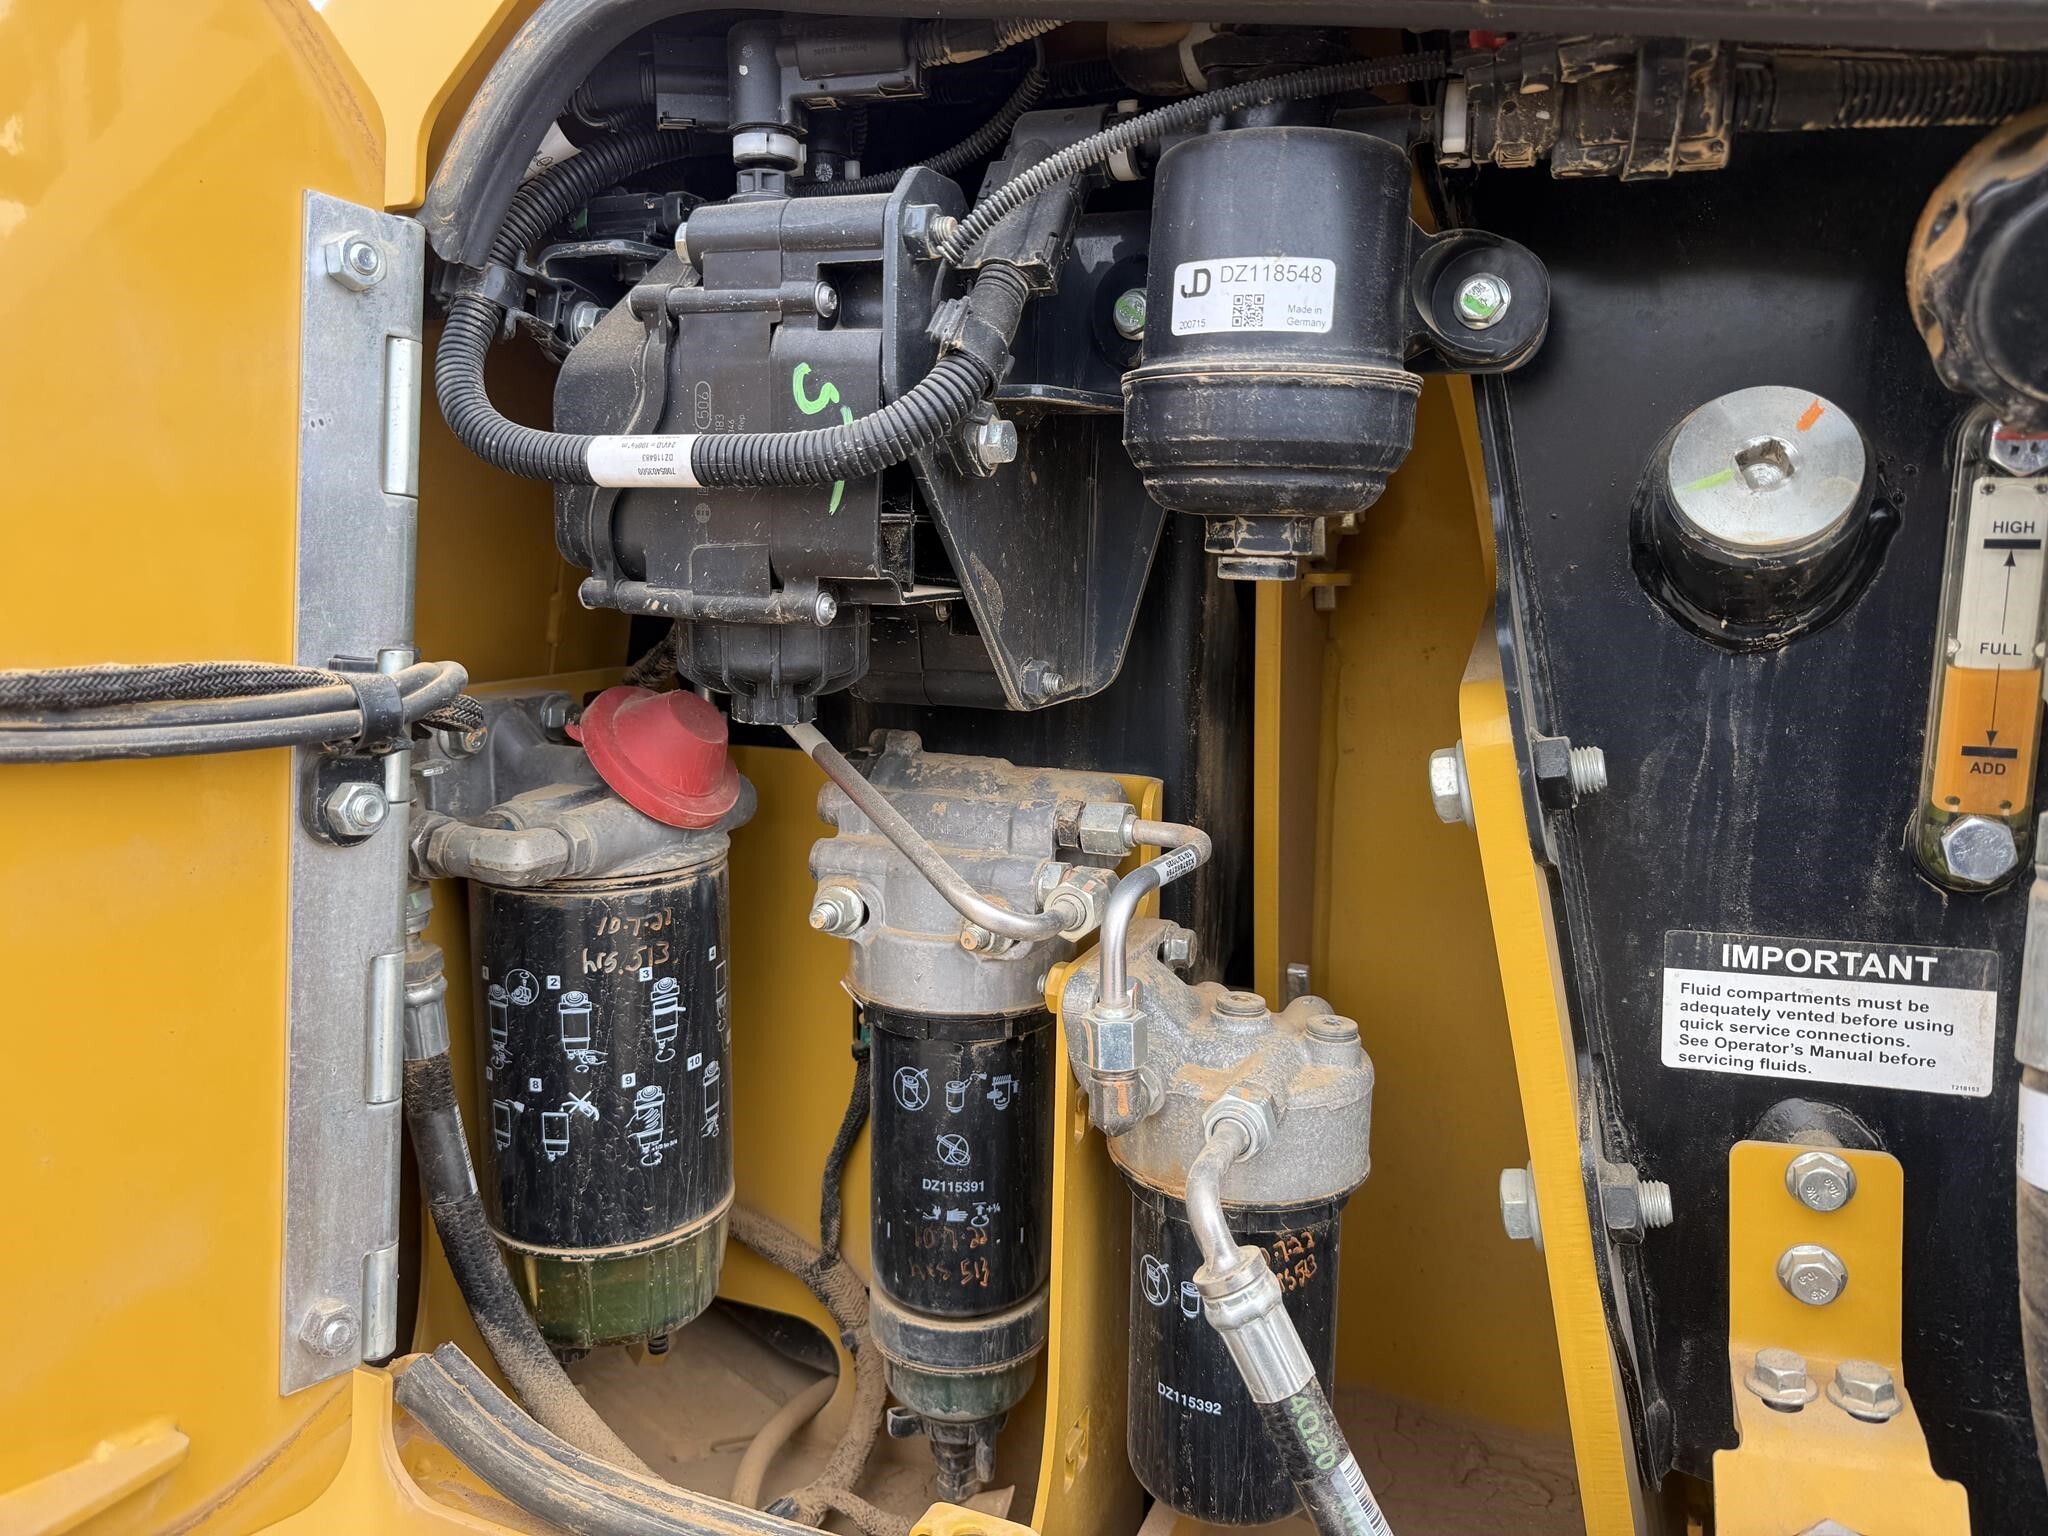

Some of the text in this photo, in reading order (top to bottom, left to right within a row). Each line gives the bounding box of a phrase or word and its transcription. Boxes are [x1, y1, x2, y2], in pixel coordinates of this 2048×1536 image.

[1220, 264, 1323, 283] DZ118548
[1287, 304, 1322, 314] Made in
[1179, 318, 1206, 330] 200715
[1286, 316, 1326, 329] Germany
[698, 391, 710, 419] 506
[1992, 519, 2035, 534] HIGH
[1979, 642, 2022, 657] FULL
[1970, 761, 2006, 776] ADD
[1722, 943, 1938, 982] IMPORTANT
[1680, 982, 1930, 1013] Fluid compartments must be
[1680, 1000, 1954, 1037] adequately vented before using
[1680, 1017, 1911, 1048] quick service connections.
[1679, 1033, 1936, 1068] See Operator's Manual before
[1679, 1051, 1812, 1074] servicing fluids.
[922, 1178, 985, 1193] DZ115391
[1157, 1382, 1222, 1415] DZ115392
